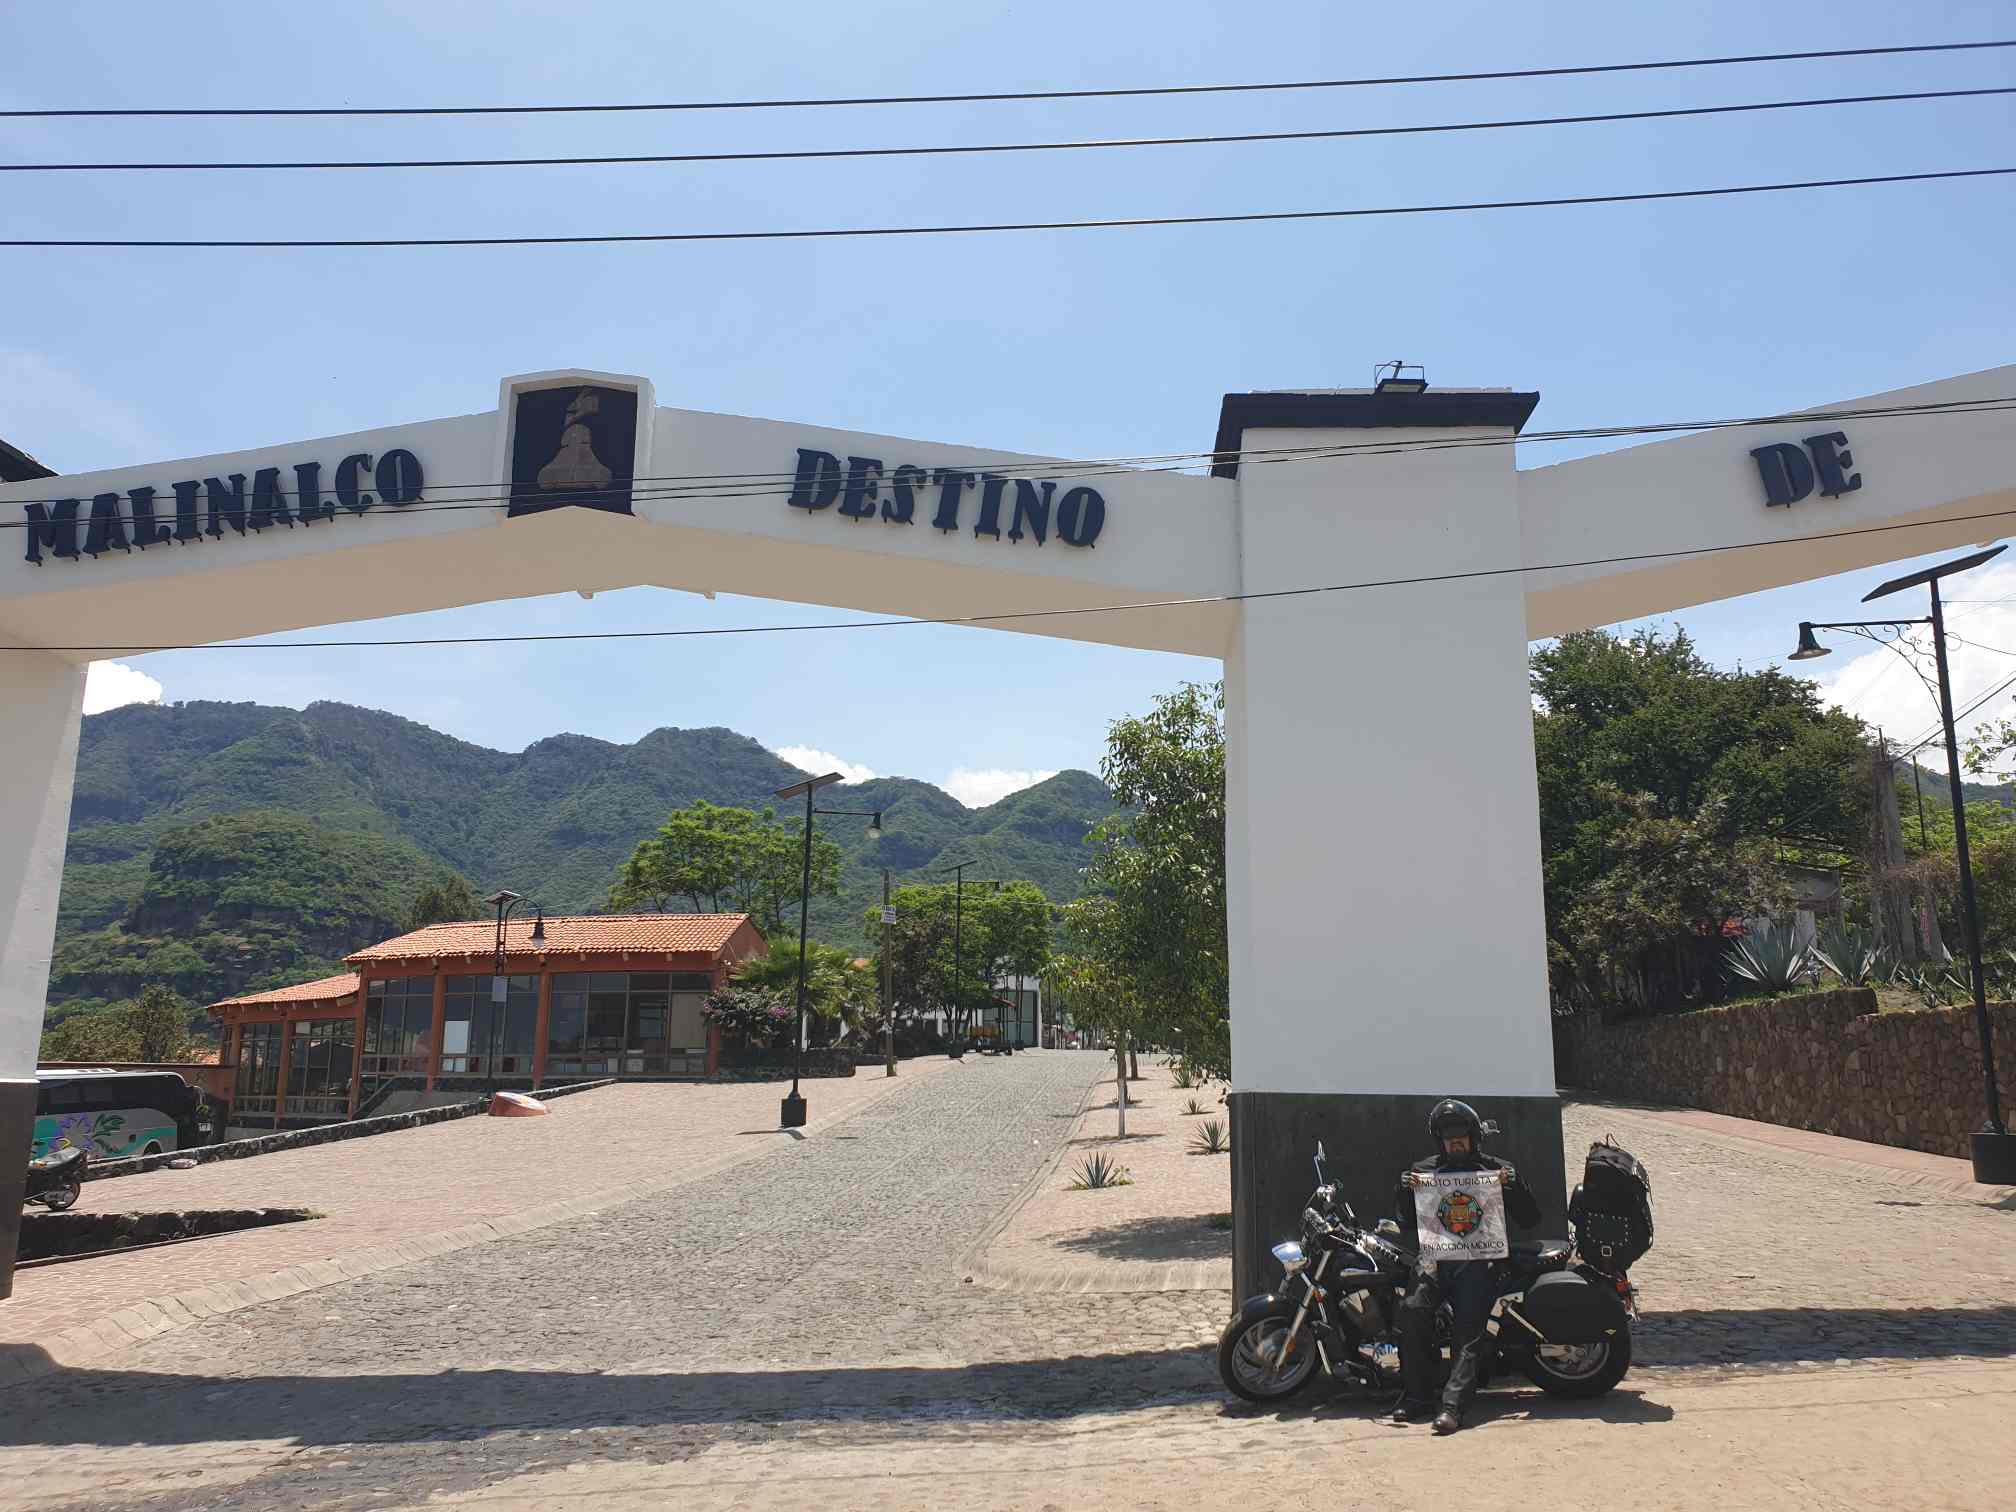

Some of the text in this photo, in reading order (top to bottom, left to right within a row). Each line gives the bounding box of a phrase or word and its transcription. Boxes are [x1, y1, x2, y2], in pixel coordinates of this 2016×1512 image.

[24, 431, 1862, 563] MALINALCO DESTINO DE
[1422, 1175, 1492, 1187] MOTO TURISTA
[1424, 1243, 1434, 1252] EN
